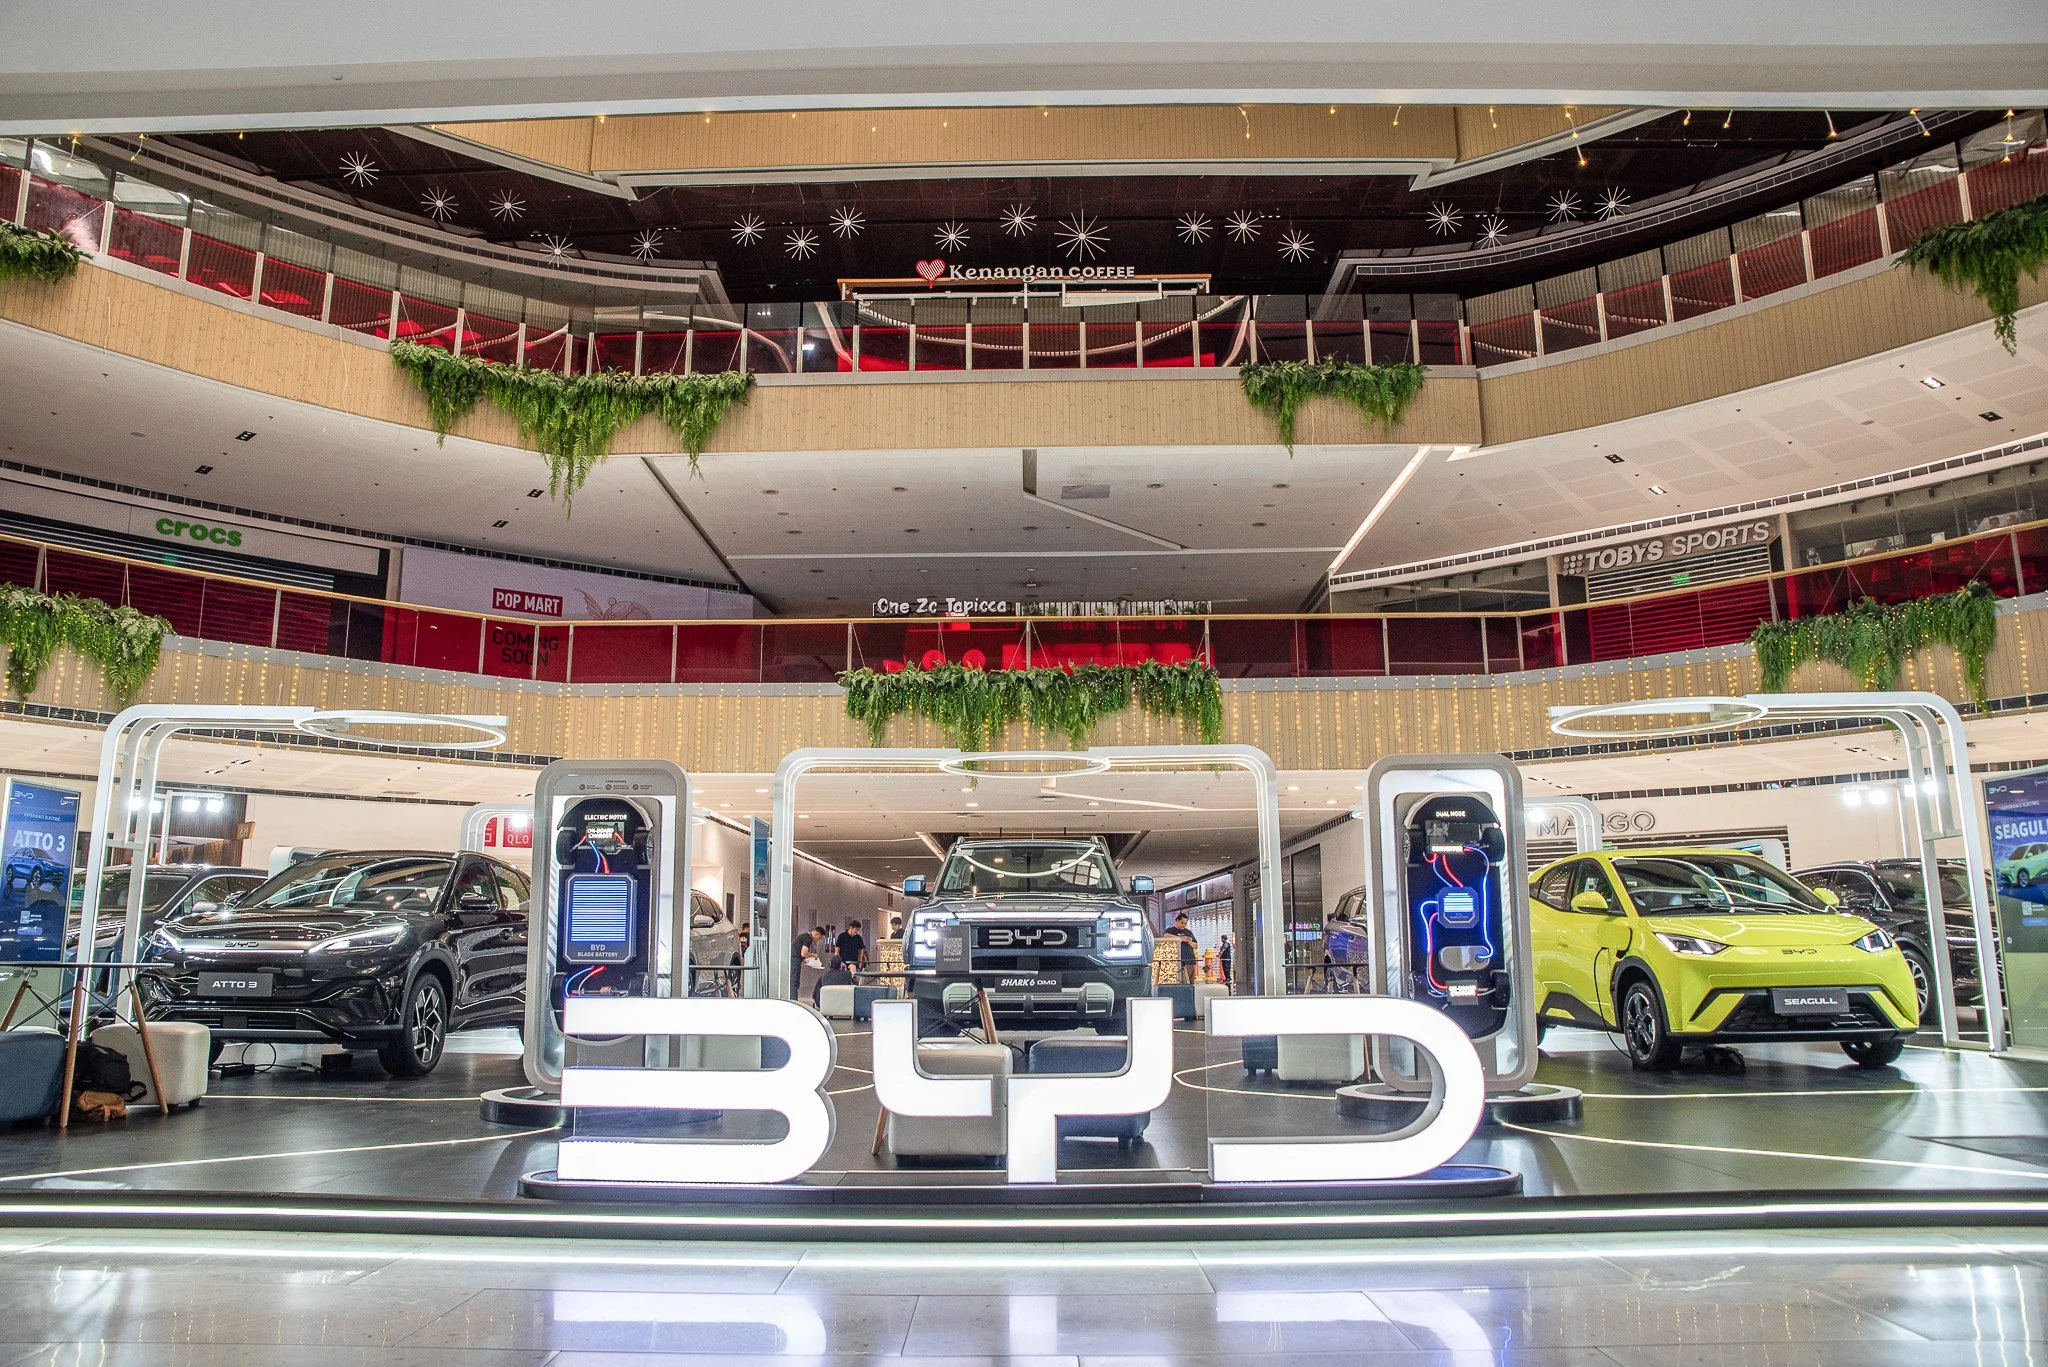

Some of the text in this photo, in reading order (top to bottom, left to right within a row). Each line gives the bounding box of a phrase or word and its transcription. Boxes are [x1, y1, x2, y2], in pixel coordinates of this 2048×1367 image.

[949, 264, 1135, 283] Kenangan COFFEE
[155, 517, 242, 547] crocs
[1585, 521, 1770, 572] TOBYS SPORTS
[495, 591, 560, 614] POP MART
[877, 598, 910, 614] One
[492, 629, 560, 651] COMING
[500, 647, 549, 667] SOON
[14, 790, 34, 800] BYD
[1988, 785, 2007, 794] BYD
[1435, 810, 1450, 818] DUAL
[1995, 818, 2048, 840] SEAGUL
[12, 829, 66, 852] ATTO 3
[507, 834, 529, 846] QLO
[590, 943, 606, 951] BYD
[988, 929, 1068, 946] BYD
[1001, 978, 1029, 987] SHARK
[1029, 978, 1036, 987] 6
[557, 998, 1486, 1185] BYD
